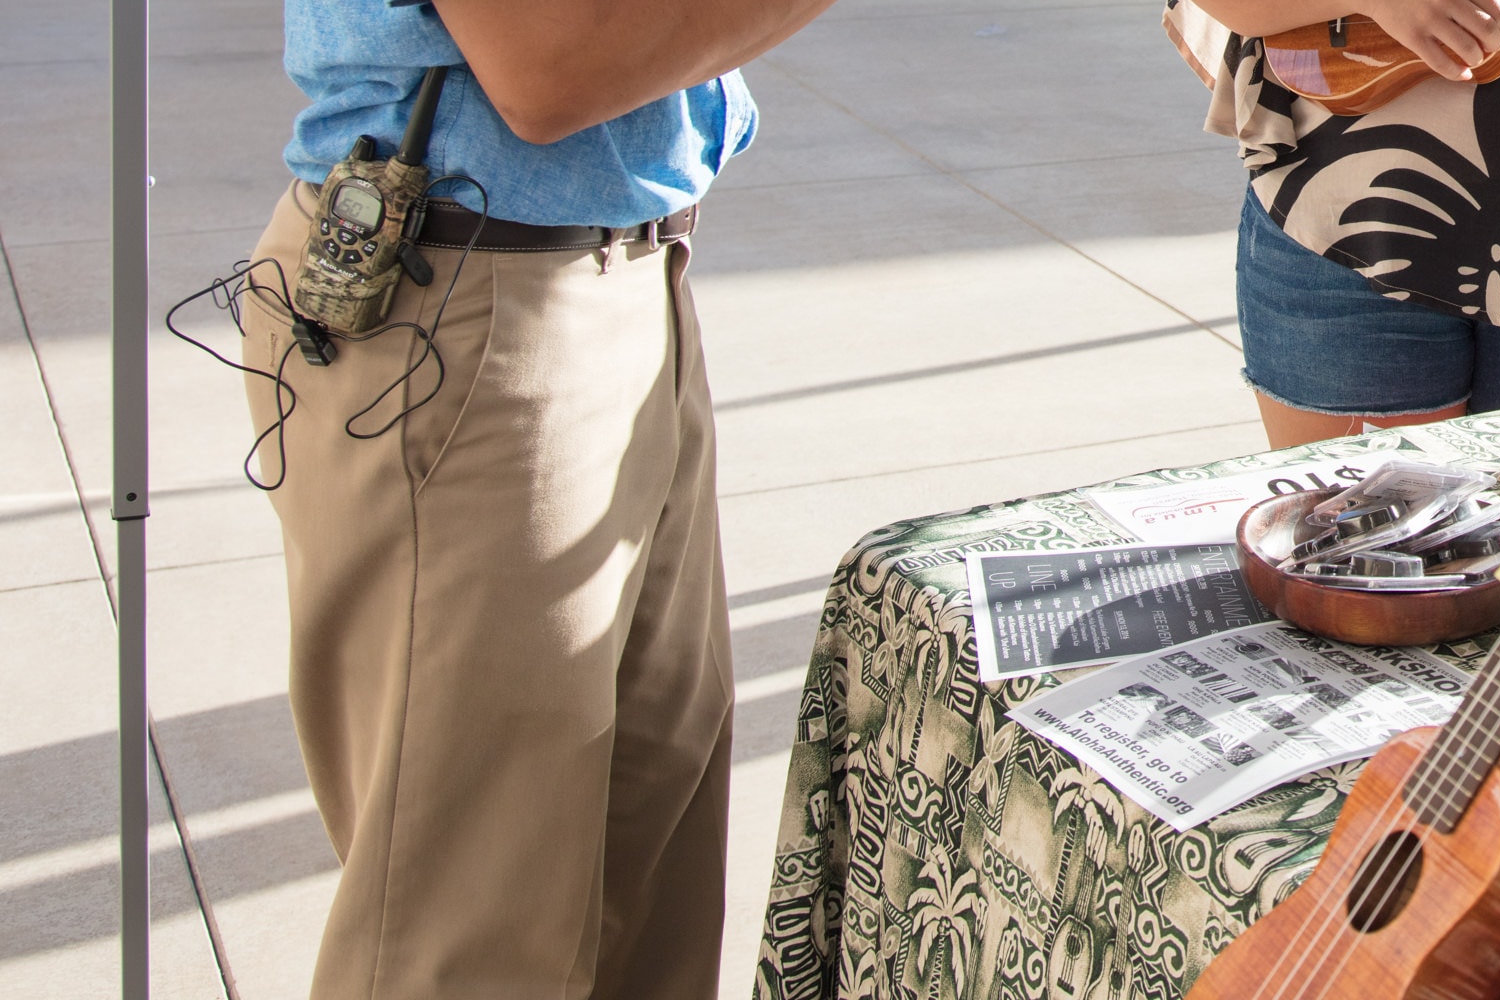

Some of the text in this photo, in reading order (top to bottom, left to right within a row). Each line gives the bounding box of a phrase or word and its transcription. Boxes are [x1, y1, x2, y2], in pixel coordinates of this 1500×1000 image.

[987, 571, 1017, 589] UP
[1025, 563, 1057, 591] LINE
[1196, 545, 1253, 629] ENTERTAINME
[1150, 610, 1168, 625] FREE
[1363, 646, 1462, 696] RKSHO
[1034, 707, 1195, 815] www.AlohaAuthentic.org
[1078, 710, 1188, 785] To register, go to
